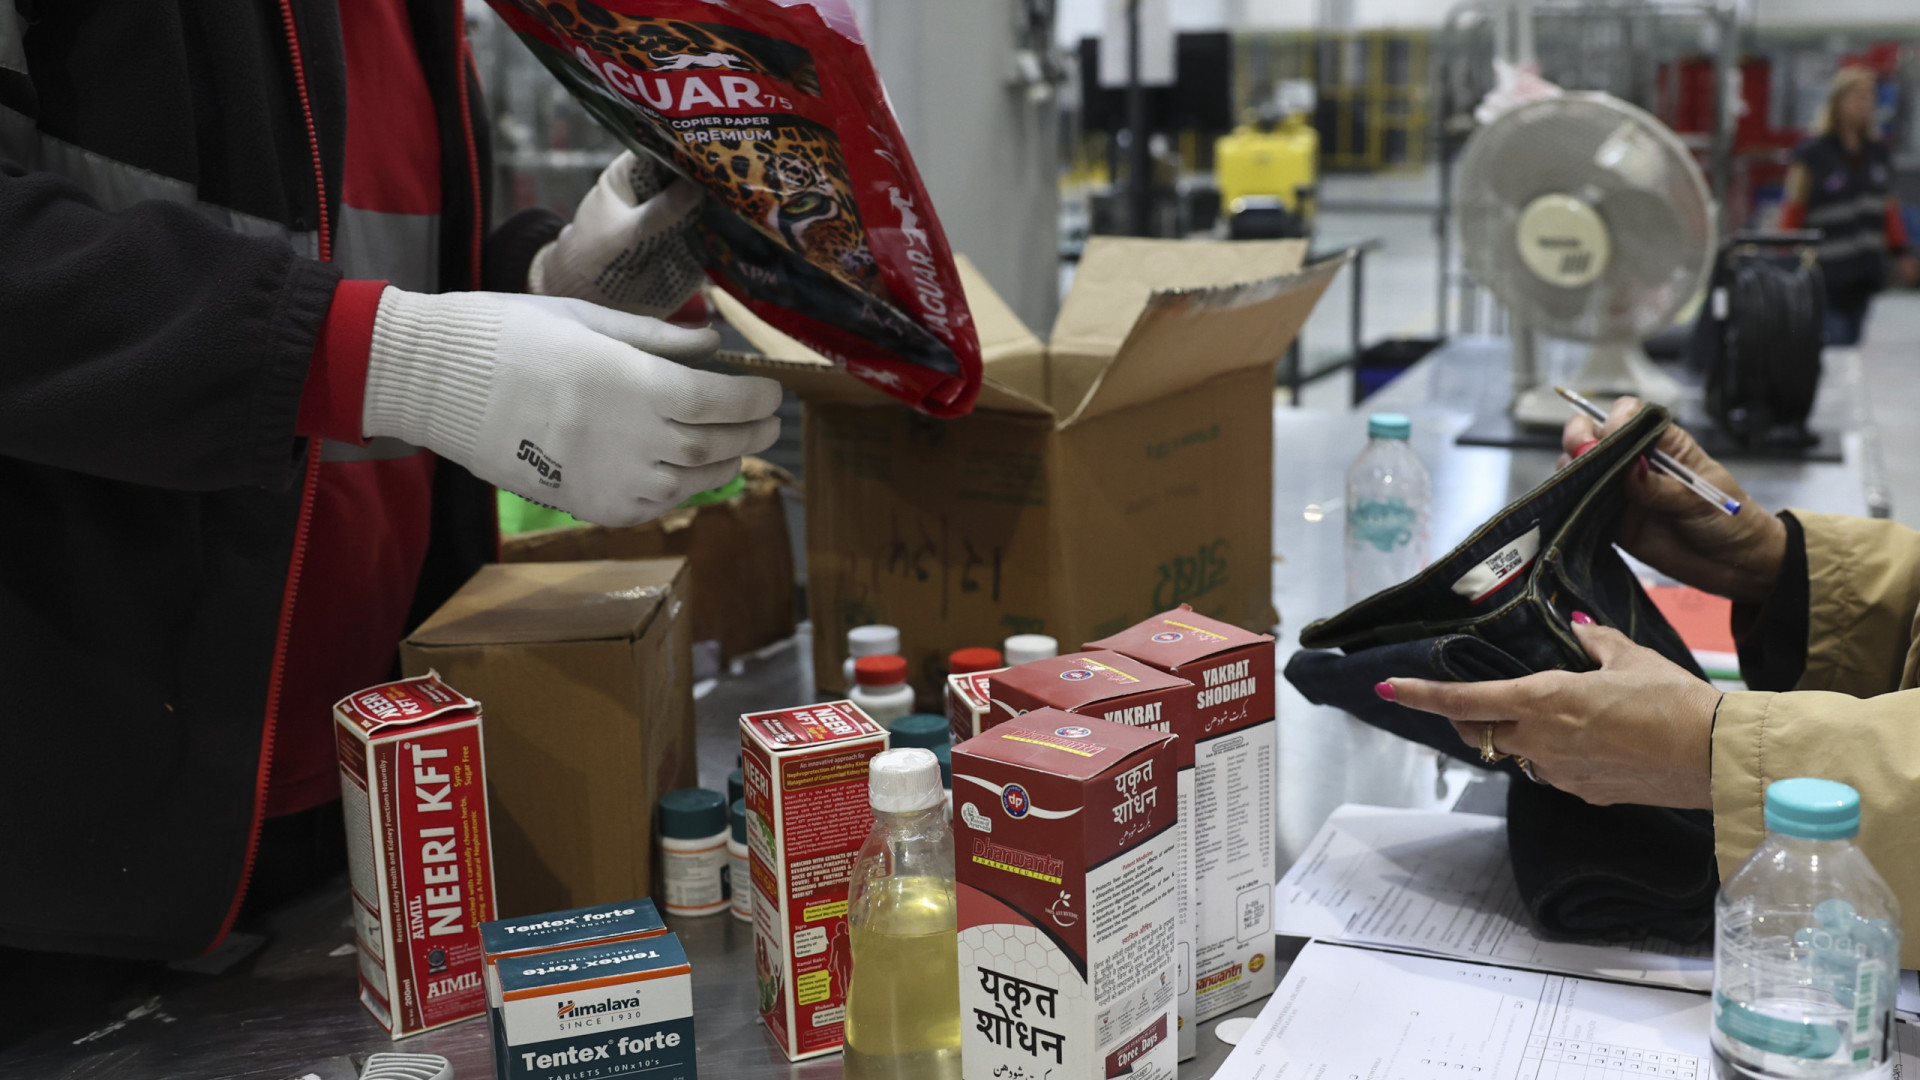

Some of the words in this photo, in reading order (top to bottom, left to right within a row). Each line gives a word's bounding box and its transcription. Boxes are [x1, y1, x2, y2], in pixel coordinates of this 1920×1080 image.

[575, 46, 764, 112] AGUAR
[763, 94, 793, 110] 75
[671, 116, 722, 129] COPIER
[725, 116, 770, 127] PAPER
[683, 129, 773, 144] PREMIUM
[906, 250, 956, 341] JAGUAR
[516, 446, 563, 483] JUBA
[1202, 659, 1250, 688] YAKRAT
[357, 692, 403, 720] NEERI
[394, 697, 423, 716] KFT
[1196, 677, 1256, 710] SHODHAN
[791, 711, 820, 727] KFT
[811, 707, 858, 737] NEERI
[1104, 702, 1163, 728] YAKRAT
[464, 761, 472, 787] Sugar
[808, 759, 833, 767] innovative
[834, 754, 857, 763] approach
[411, 744, 453, 813] KFT
[453, 765, 462, 787] Syrup
[743, 757, 769, 801] NEERI
[1114, 758, 1153, 795] यकृत
[745, 780, 757, 807] KFT
[1008, 793, 1023, 808] dp
[1112, 786, 1157, 825] शोधन
[382, 793, 393, 827] Functions
[385, 827, 395, 851] Kidney
[461, 819, 471, 847] chosen
[474, 856, 483, 886] Natural
[790, 860, 811, 868] ENRICHED
[825, 853, 845, 861] EXTRACTS
[972, 837, 1064, 878] Dhanwantri
[973, 857, 1062, 884] PHARMACEUTICAL
[389, 865, 398, 890] Health
[419, 826, 464, 937] NEERI
[393, 890, 402, 914] Kidney
[409, 895, 425, 940] AIMIL
[504, 917, 578, 934] Tentex
[582, 908, 636, 922] forte
[527, 926, 570, 937] TABLETS
[522, 963, 580, 977] forte
[585, 950, 661, 968] Tentex
[404, 978, 412, 1007] 200ml
[426, 971, 482, 1000] AIMIL
[977, 966, 1059, 1019] यकृत
[557, 996, 640, 1019] Himalaya
[559, 1017, 602, 1031] SINCE
[610, 1011, 641, 1023] 1930
[973, 1002, 1066, 1065] शोधन
[521, 1043, 611, 1072] Tentex
[617, 1031, 681, 1056] forte
[1117, 1046, 1139, 1067] Three
[1141, 1033, 1158, 1052] Days
[548, 1068, 601, 1080] TABLETS
